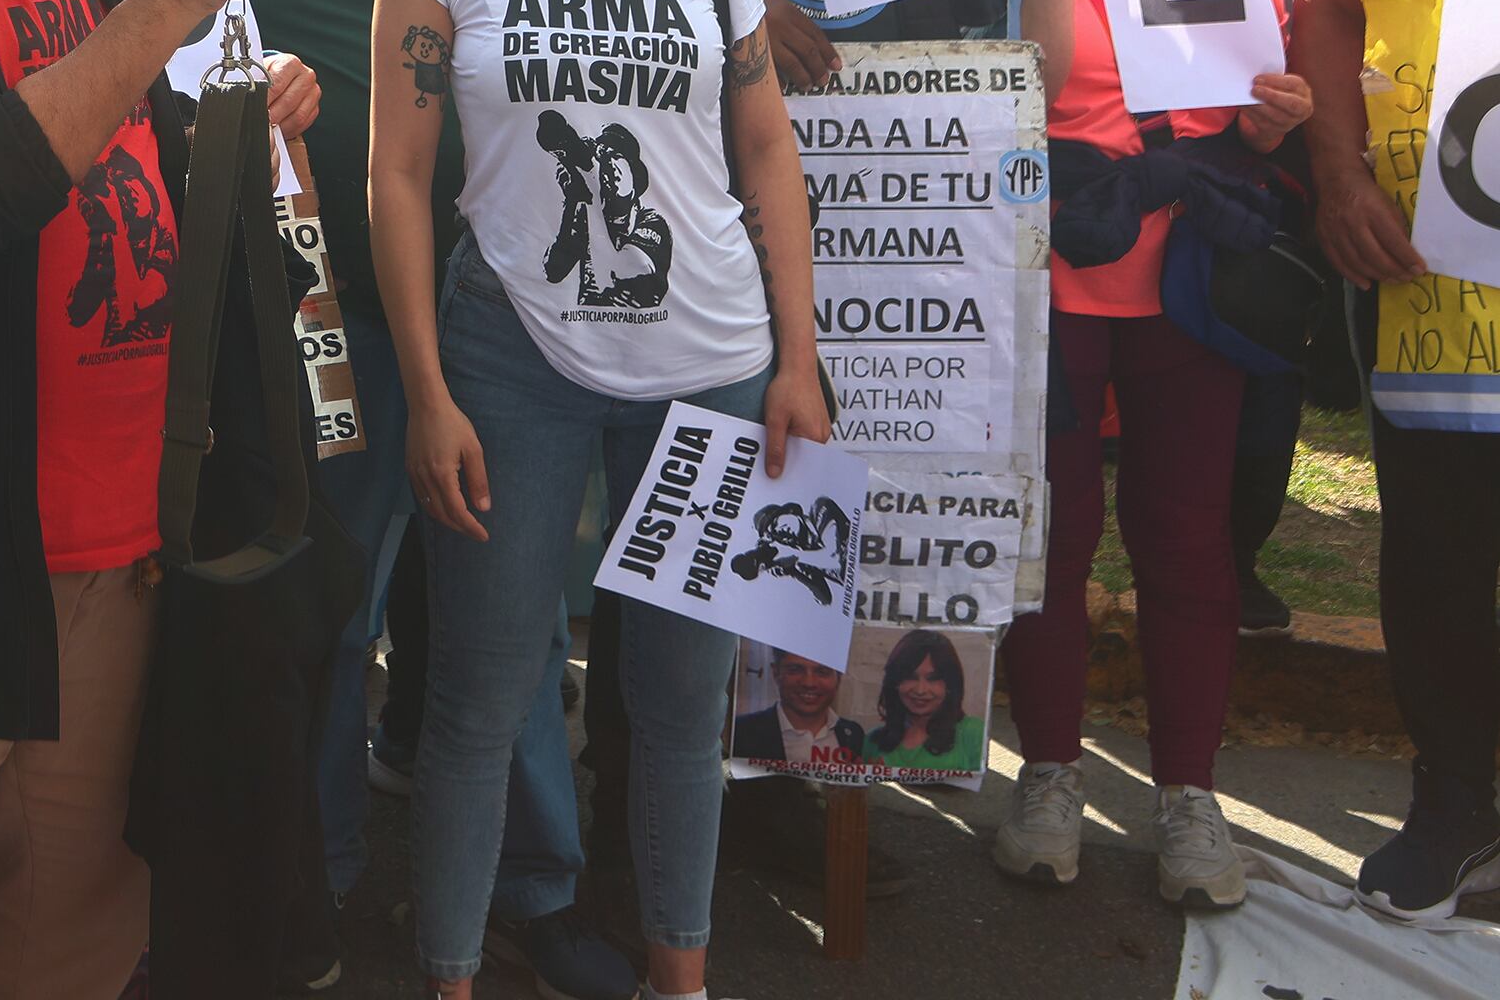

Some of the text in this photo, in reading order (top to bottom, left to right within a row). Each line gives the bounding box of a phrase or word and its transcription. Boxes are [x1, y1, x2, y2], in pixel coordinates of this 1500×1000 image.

[503, 32, 699, 70] DE CREACIÓN
[503, 58, 692, 114] MASIVA
[989, 67, 1027, 92] DE
[884, 118, 912, 148] A
[924, 117, 969, 147] LA
[881, 172, 929, 202] DE
[941, 172, 992, 202] TU
[1005, 157, 1044, 196] YPF
[814, 227, 964, 258] RMANA
[560, 309, 669, 325] #JUSTICIAPORPABLOGRILLO
[1396, 328, 1442, 373] NO
[825, 355, 965, 379] TICIA POR
[315, 412, 358, 443] ES
[617, 425, 714, 582] JUSTICIA
[682, 436, 760, 602] PABLO GRILLO
[938, 495, 1020, 519] PARA
[842, 507, 861, 617] #FUERZAPABLOGRILLO
[859, 534, 998, 570] BLITO
[854, 589, 979, 626] RILLO
[810, 745, 853, 765] NO
[813, 770, 861, 784] CORTE
[871, 766, 892, 776] DE
[898, 767, 974, 779] CRISTINA
